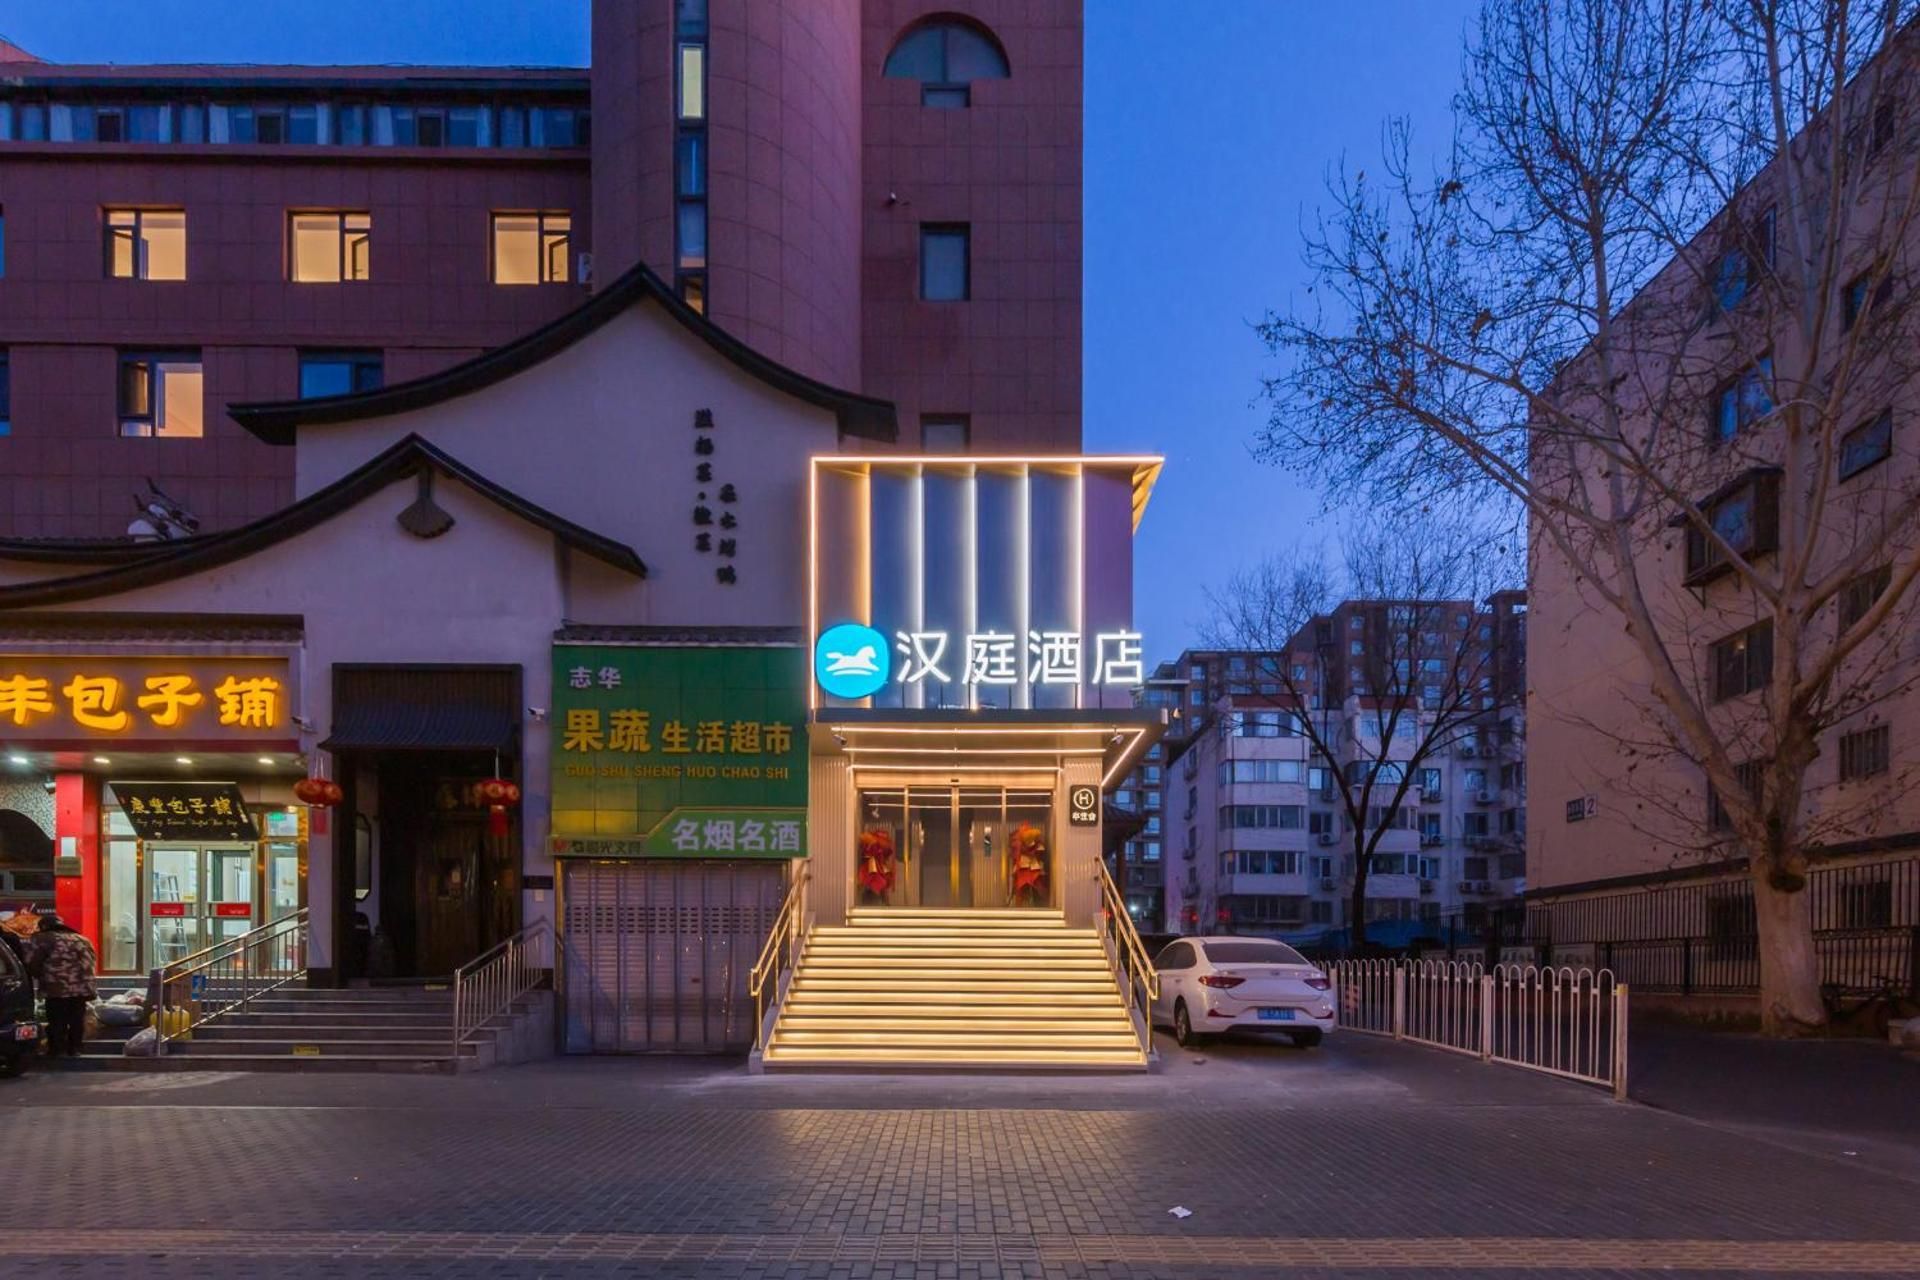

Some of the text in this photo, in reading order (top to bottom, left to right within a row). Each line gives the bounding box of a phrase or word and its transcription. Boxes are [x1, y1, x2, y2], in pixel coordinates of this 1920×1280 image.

[896, 630, 1144, 684] 汉庭酒店
[569, 666, 622, 689] 志华
[0, 675, 279, 731] 丰包子铺
[563, 709, 793, 754] 果蔬 生活超市
[634, 766, 681, 778] SHENG
[687, 767, 716, 778] HUO
[722, 767, 760, 778] CHAO
[766, 768, 788, 779] SHI
[1587, 798, 1595, 814] 2
[671, 820, 800, 851] 名烟名酒
